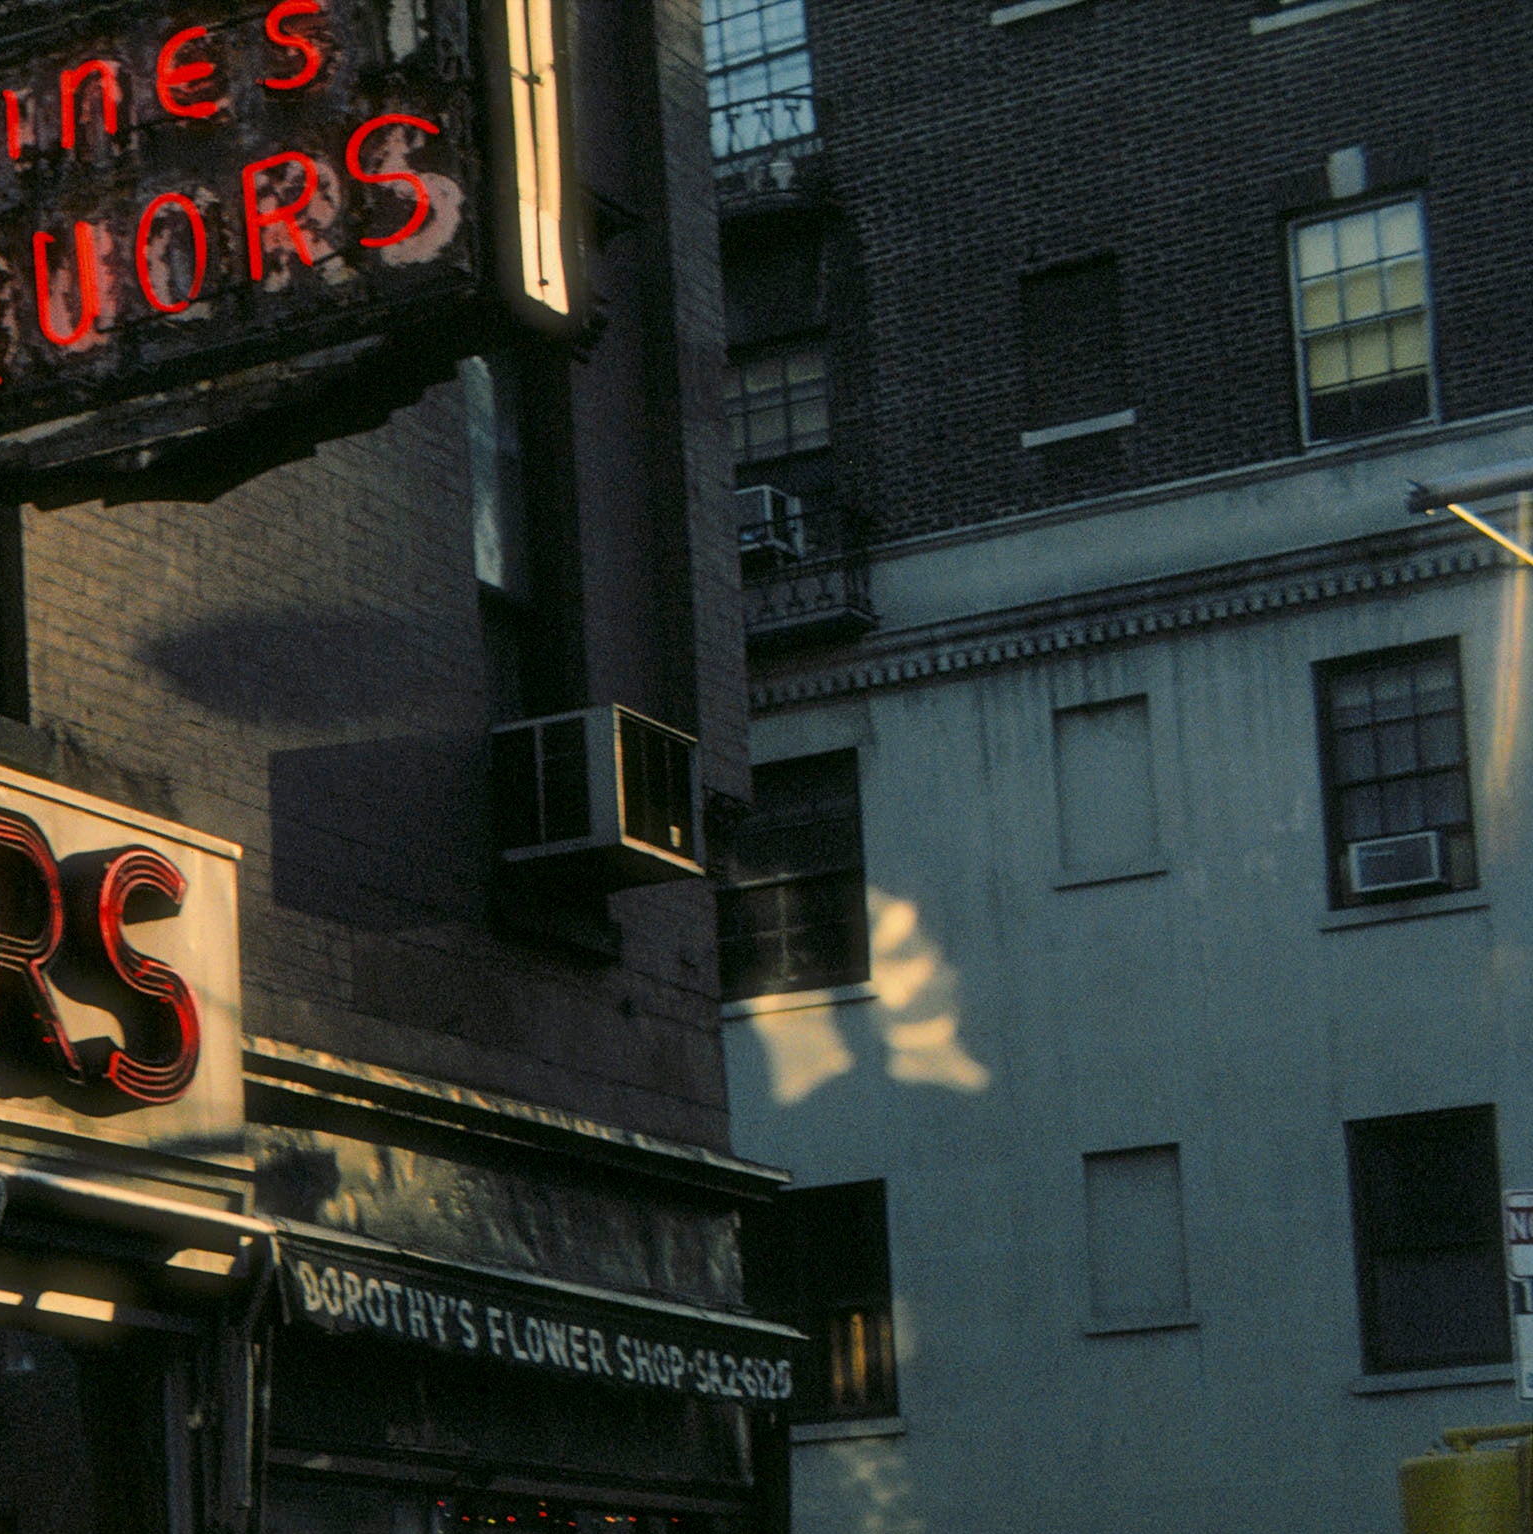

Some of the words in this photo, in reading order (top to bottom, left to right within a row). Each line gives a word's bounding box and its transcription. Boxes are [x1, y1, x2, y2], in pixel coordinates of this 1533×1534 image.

[1509, 1209, 1533, 1241] N
[295, 1258, 480, 1352] DOROTHY'S
[484, 1304, 614, 1378] FLOWER
[615, 1333, 685, 1391] SHOP
